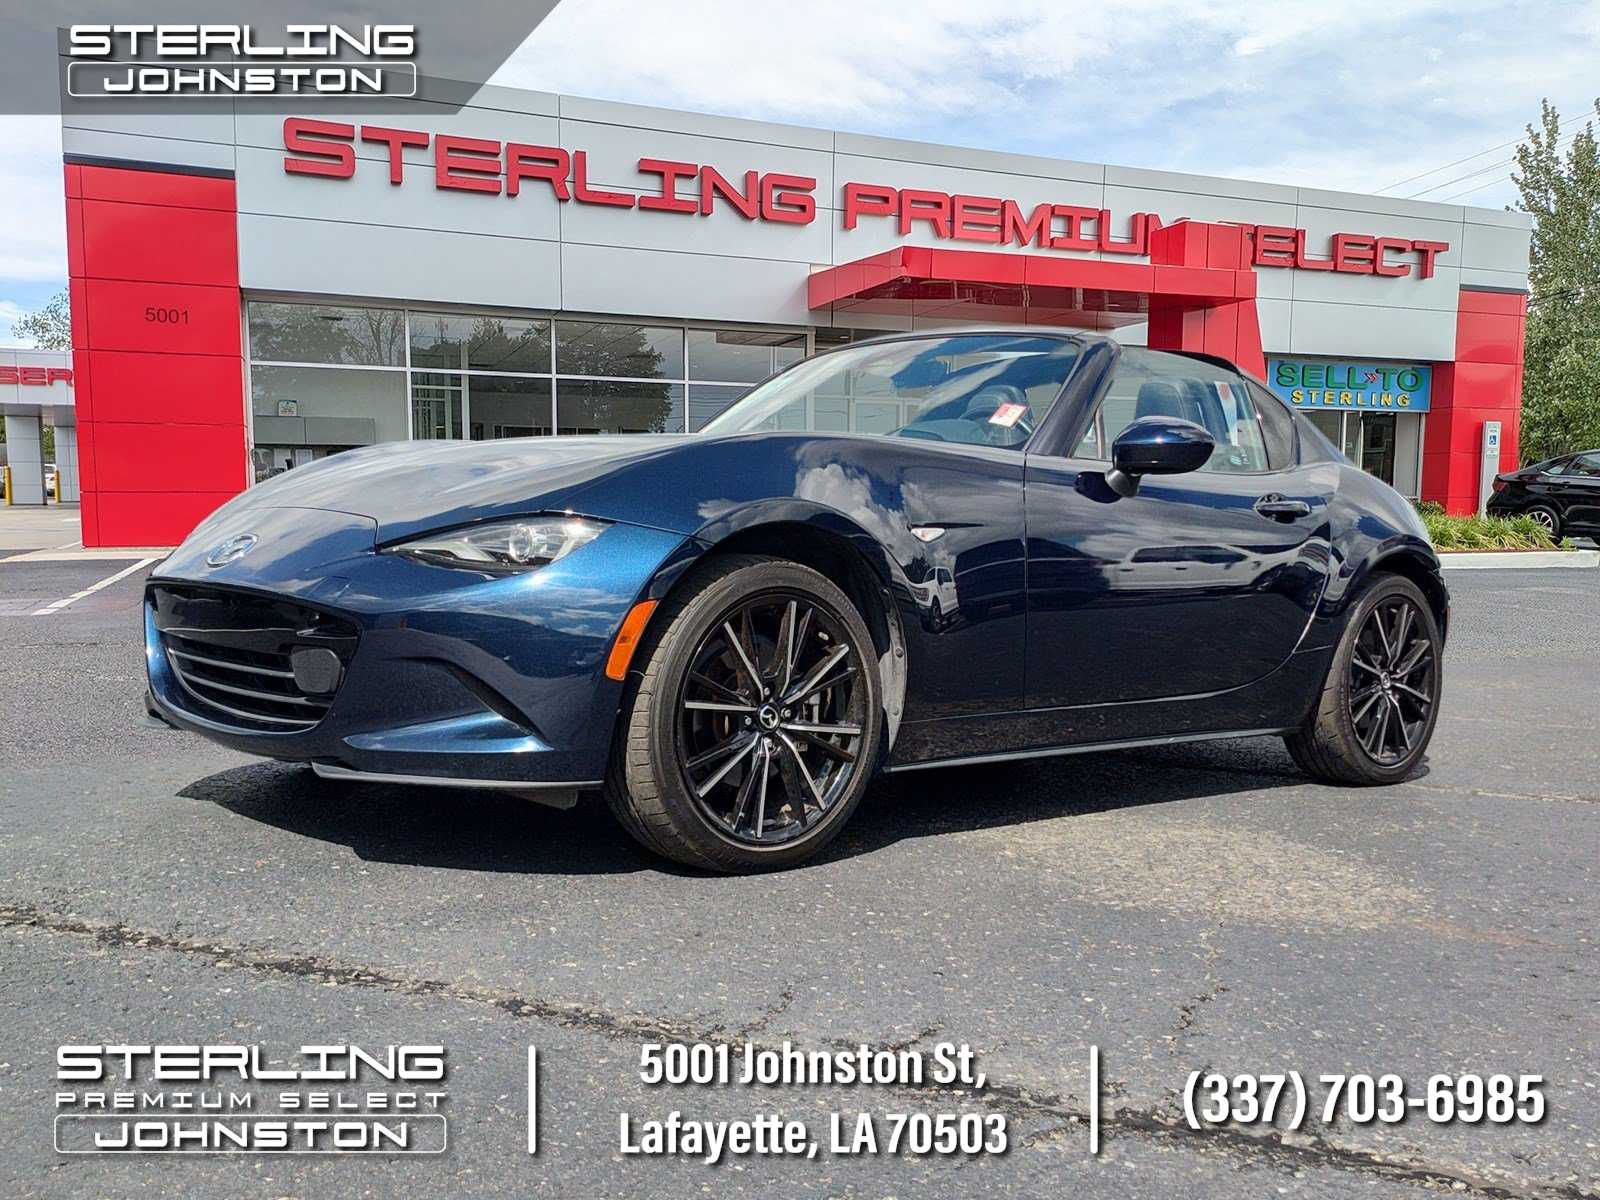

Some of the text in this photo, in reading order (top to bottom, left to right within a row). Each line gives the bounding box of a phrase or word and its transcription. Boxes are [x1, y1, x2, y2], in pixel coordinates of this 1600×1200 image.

[283, 117, 817, 226] STERLING
[145, 307, 189, 325] 5001
[1276, 362, 1424, 392] SELL TO
[1292, 389, 1411, 408] STERLING
